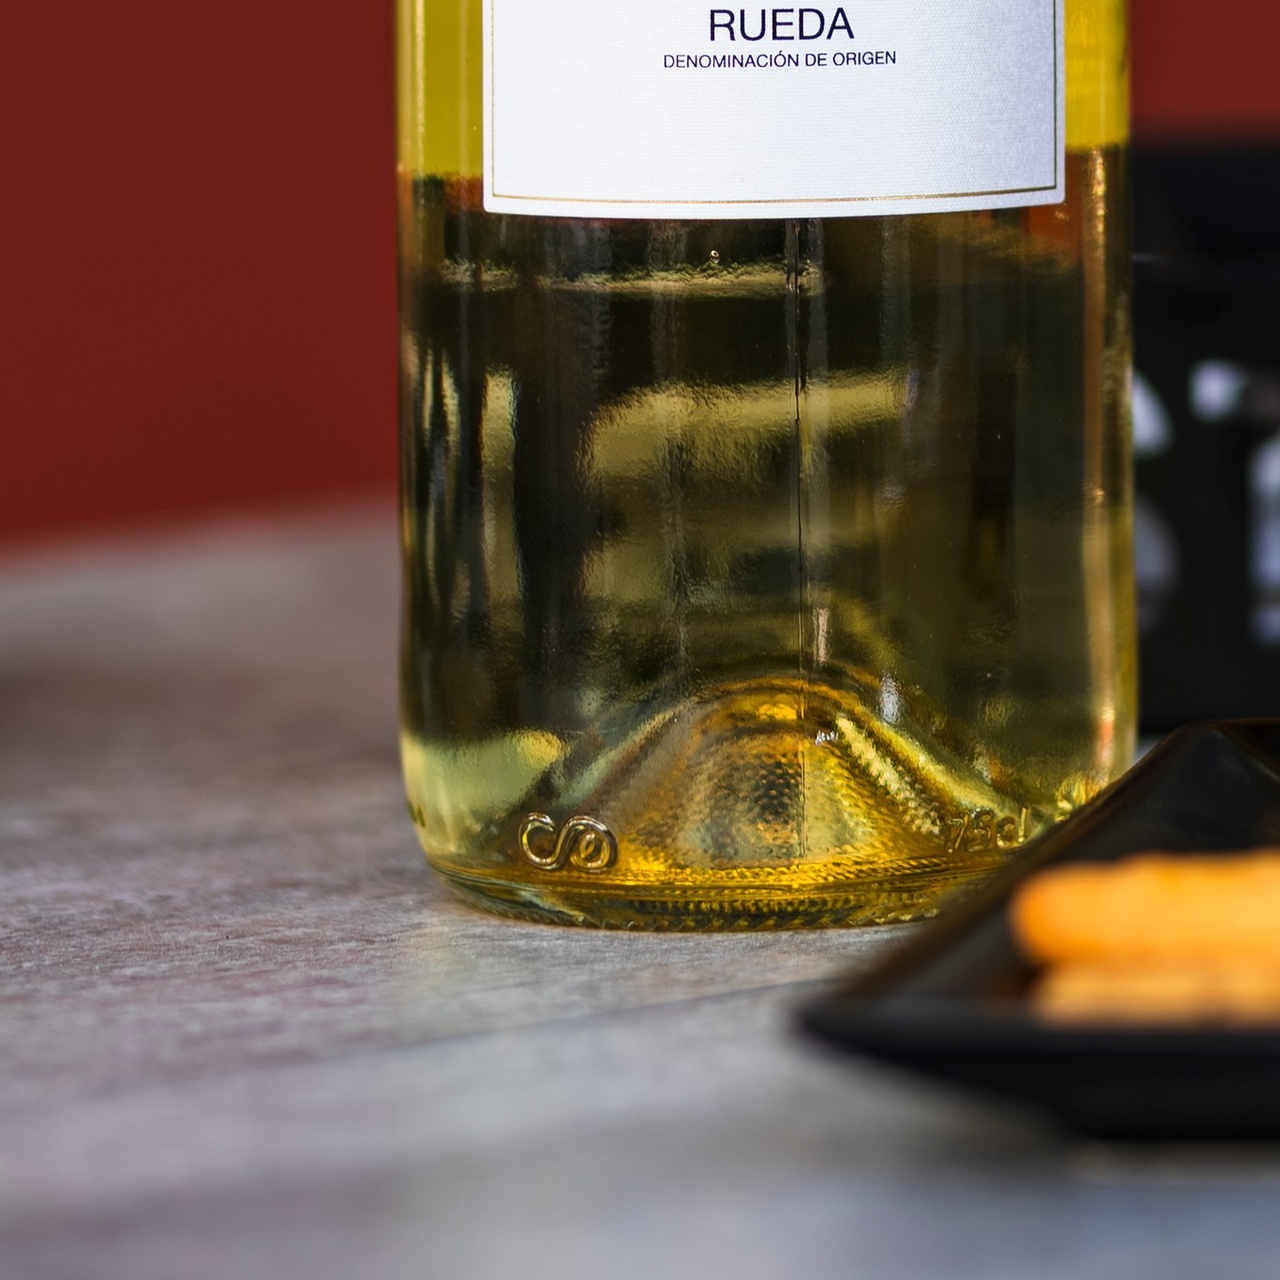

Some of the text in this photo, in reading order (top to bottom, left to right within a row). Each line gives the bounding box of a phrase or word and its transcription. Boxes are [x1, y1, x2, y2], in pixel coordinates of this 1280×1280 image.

[709, 7, 855, 42] RUEDA
[663, 49, 897, 69] DENOMINACIÓN DE ORIGEN
